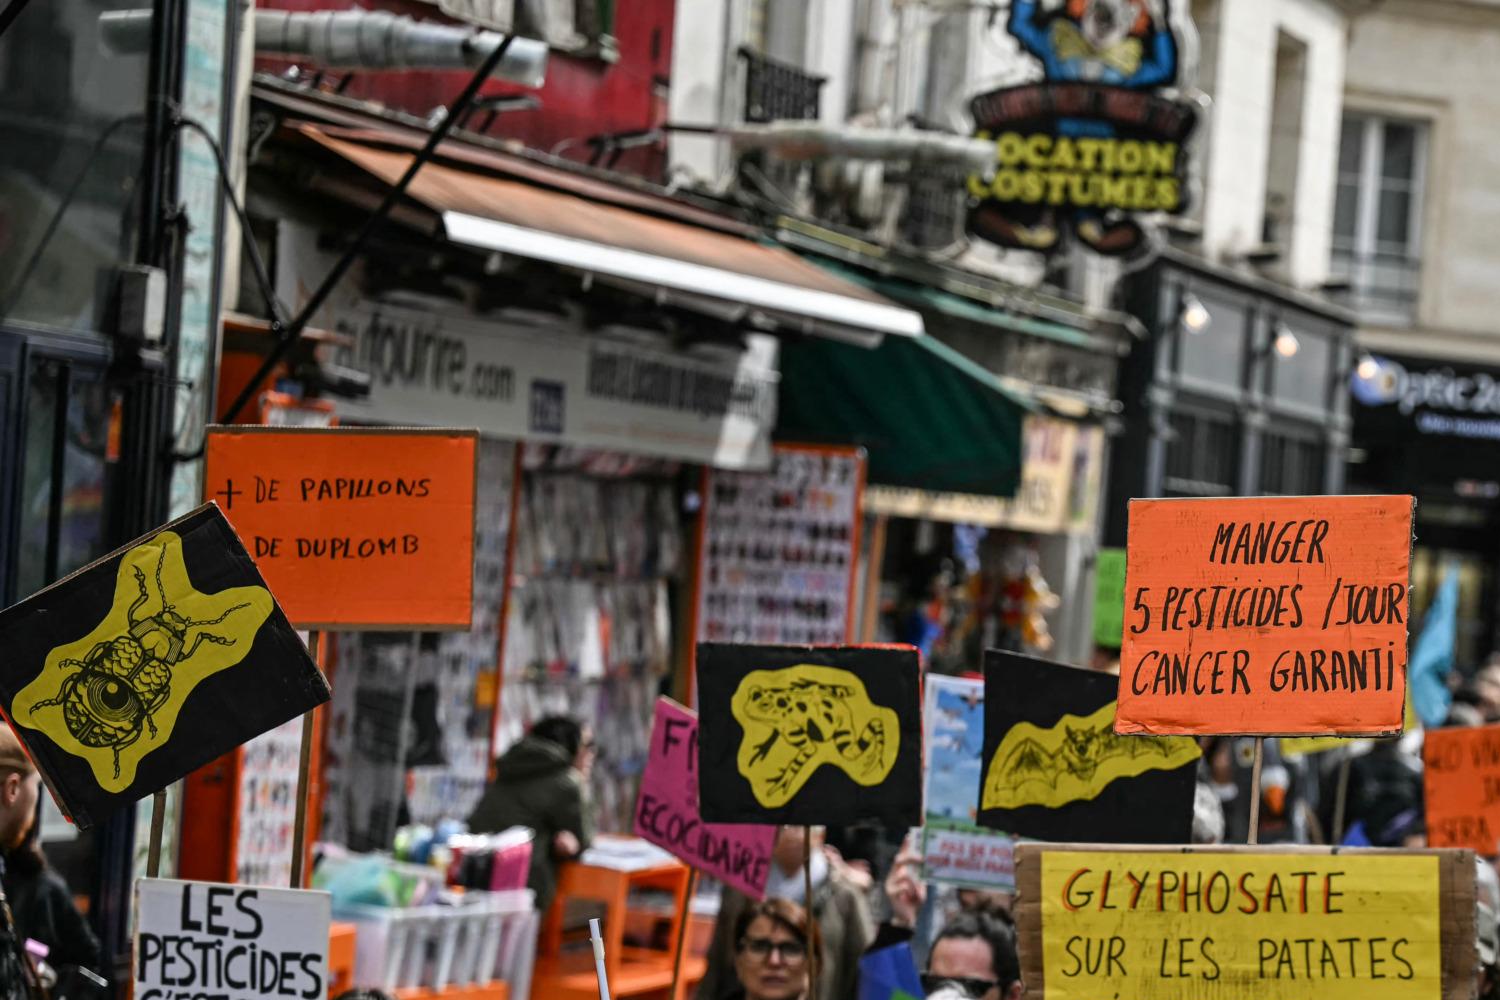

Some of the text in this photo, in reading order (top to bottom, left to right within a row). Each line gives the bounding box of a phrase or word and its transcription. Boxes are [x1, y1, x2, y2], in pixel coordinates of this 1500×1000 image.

[974, 131, 1178, 172] OCATION
[254, 476, 280, 504] DE
[300, 478, 431, 501] PAPILLONS
[254, 535, 419, 559] DE DUPLOMB
[1209, 520, 1330, 565] MANGER
[1130, 587, 1151, 634] 5
[1131, 650, 1251, 697] CANCER
[181, 884, 263, 939] LES
[1062, 867, 1345, 914] GLYPHOSATE
[1061, 935, 1414, 981] SUR LES PATATES
